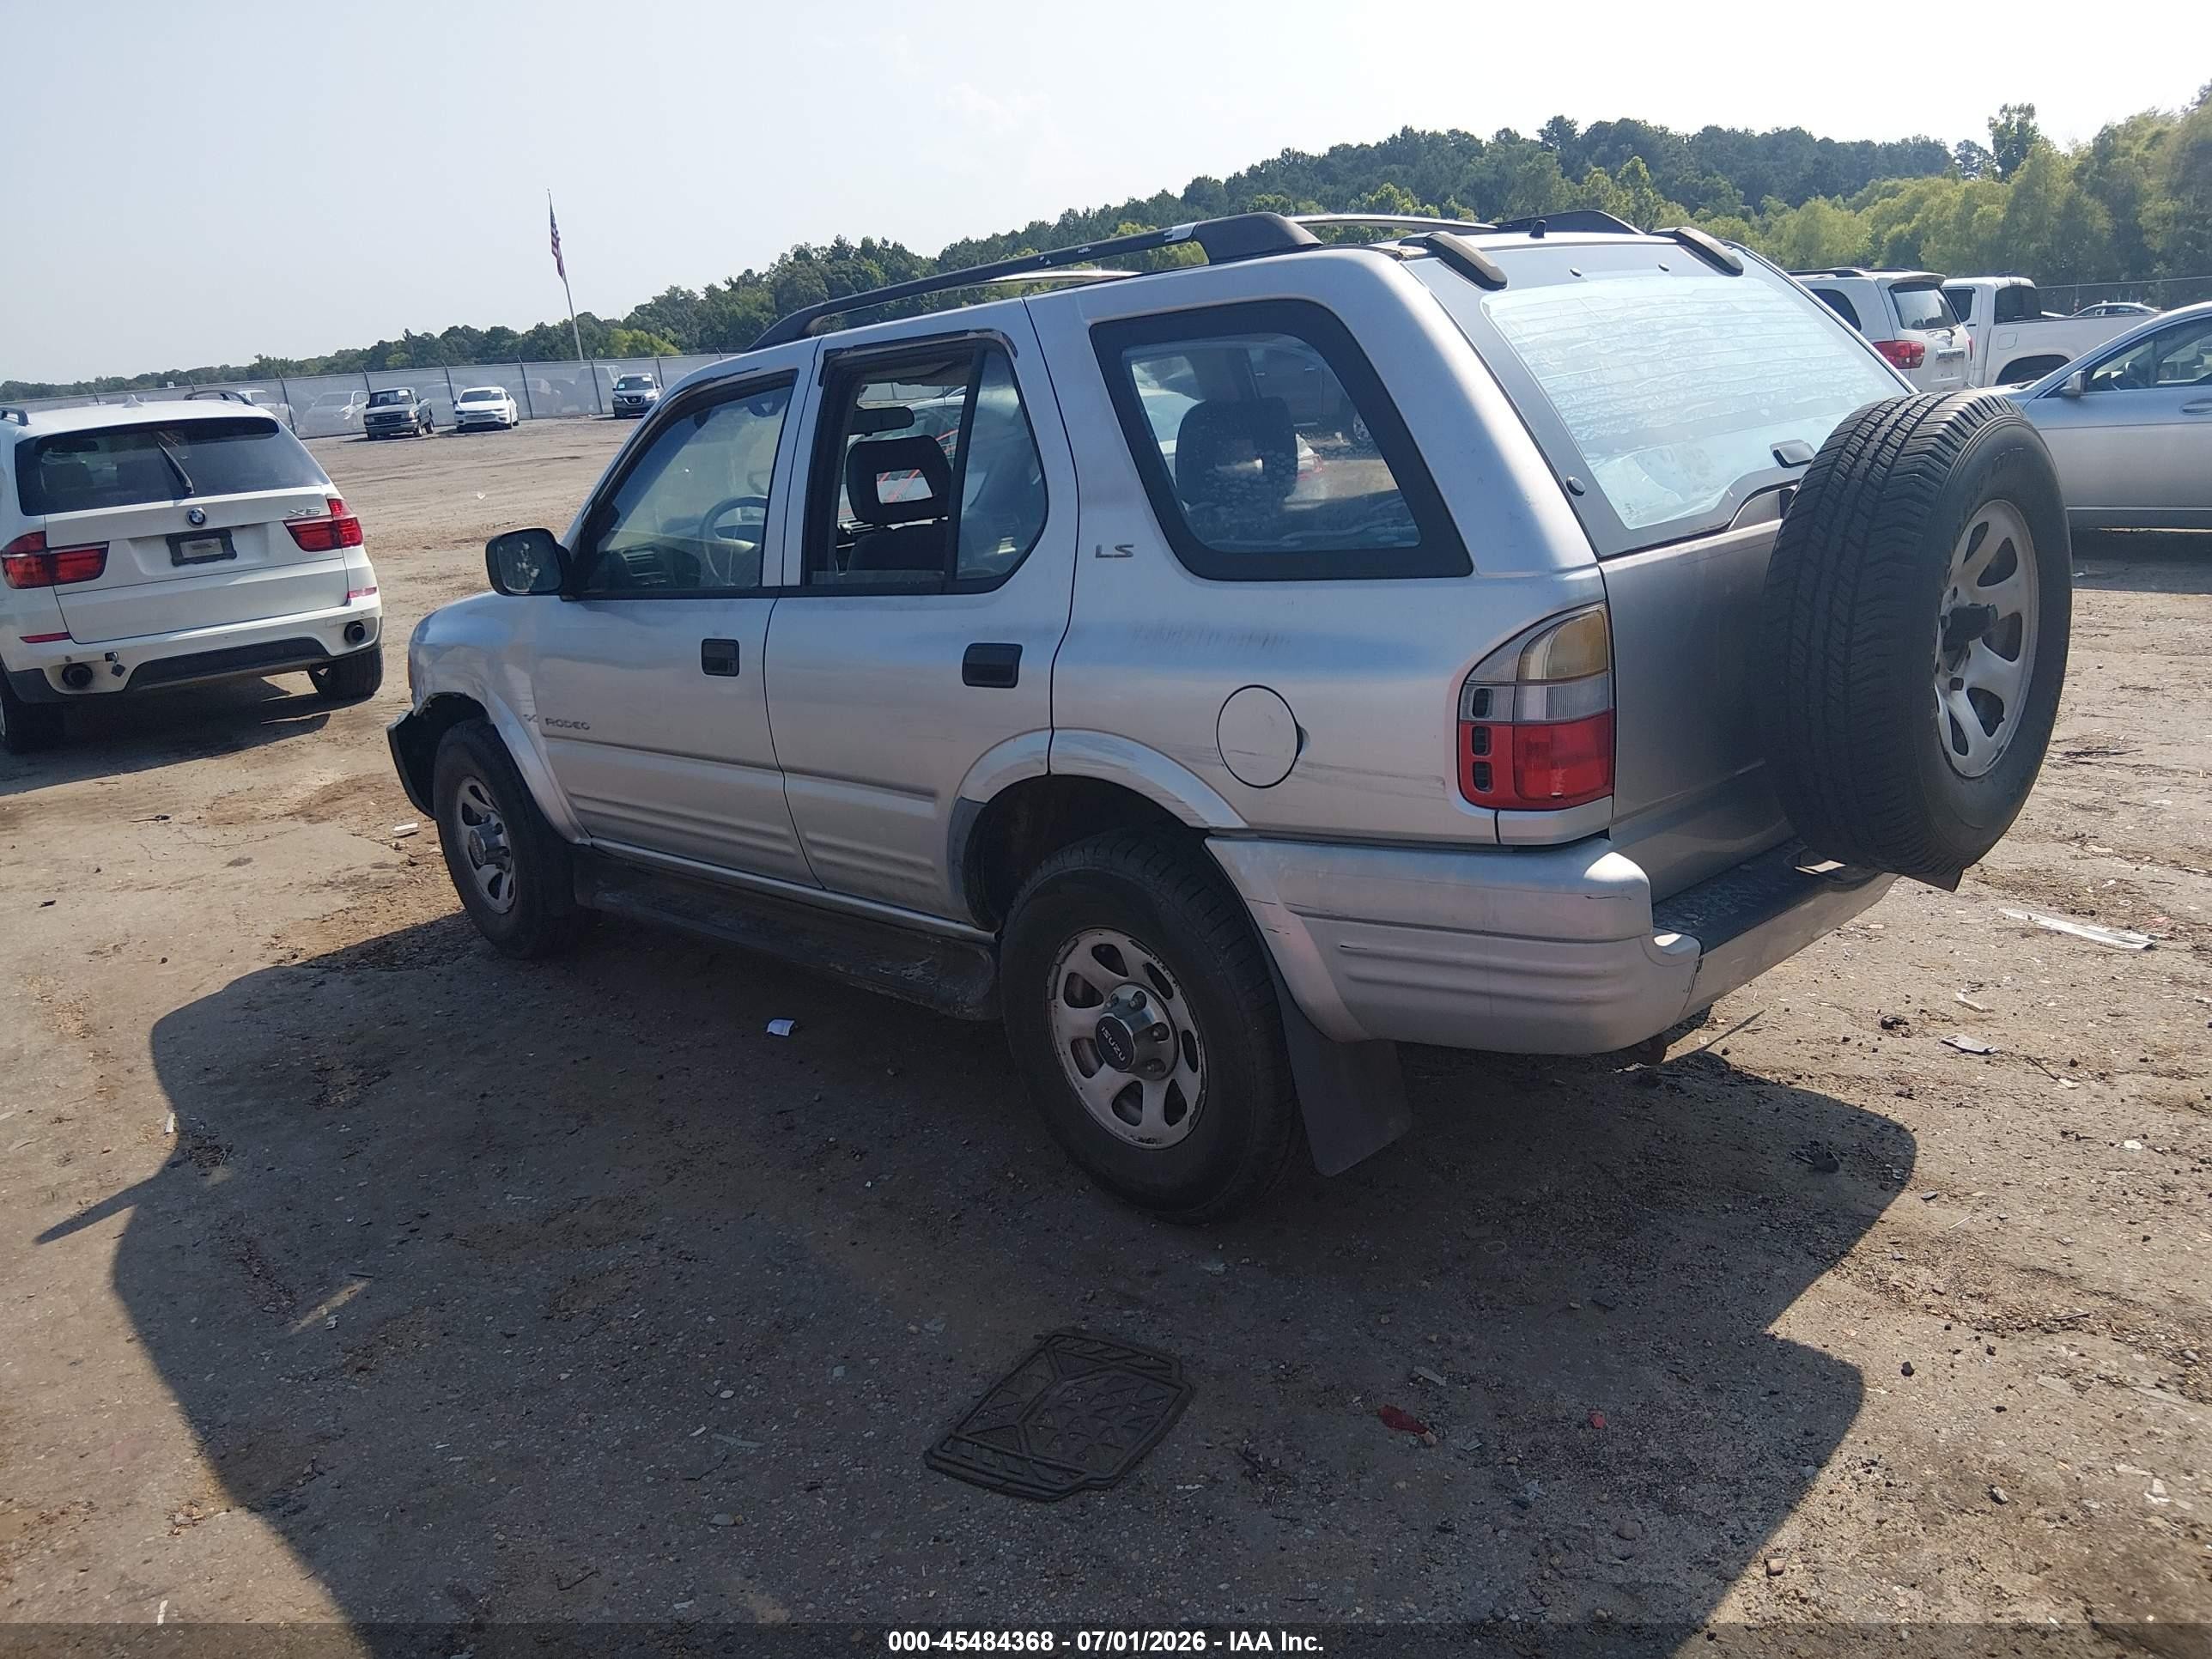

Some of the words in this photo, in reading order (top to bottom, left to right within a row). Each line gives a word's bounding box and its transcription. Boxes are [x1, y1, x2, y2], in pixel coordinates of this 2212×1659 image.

[1096, 544, 1133, 558] LS
[544, 717, 591, 731] RODEO
[1101, 1026, 1126, 1061] ISUZU
